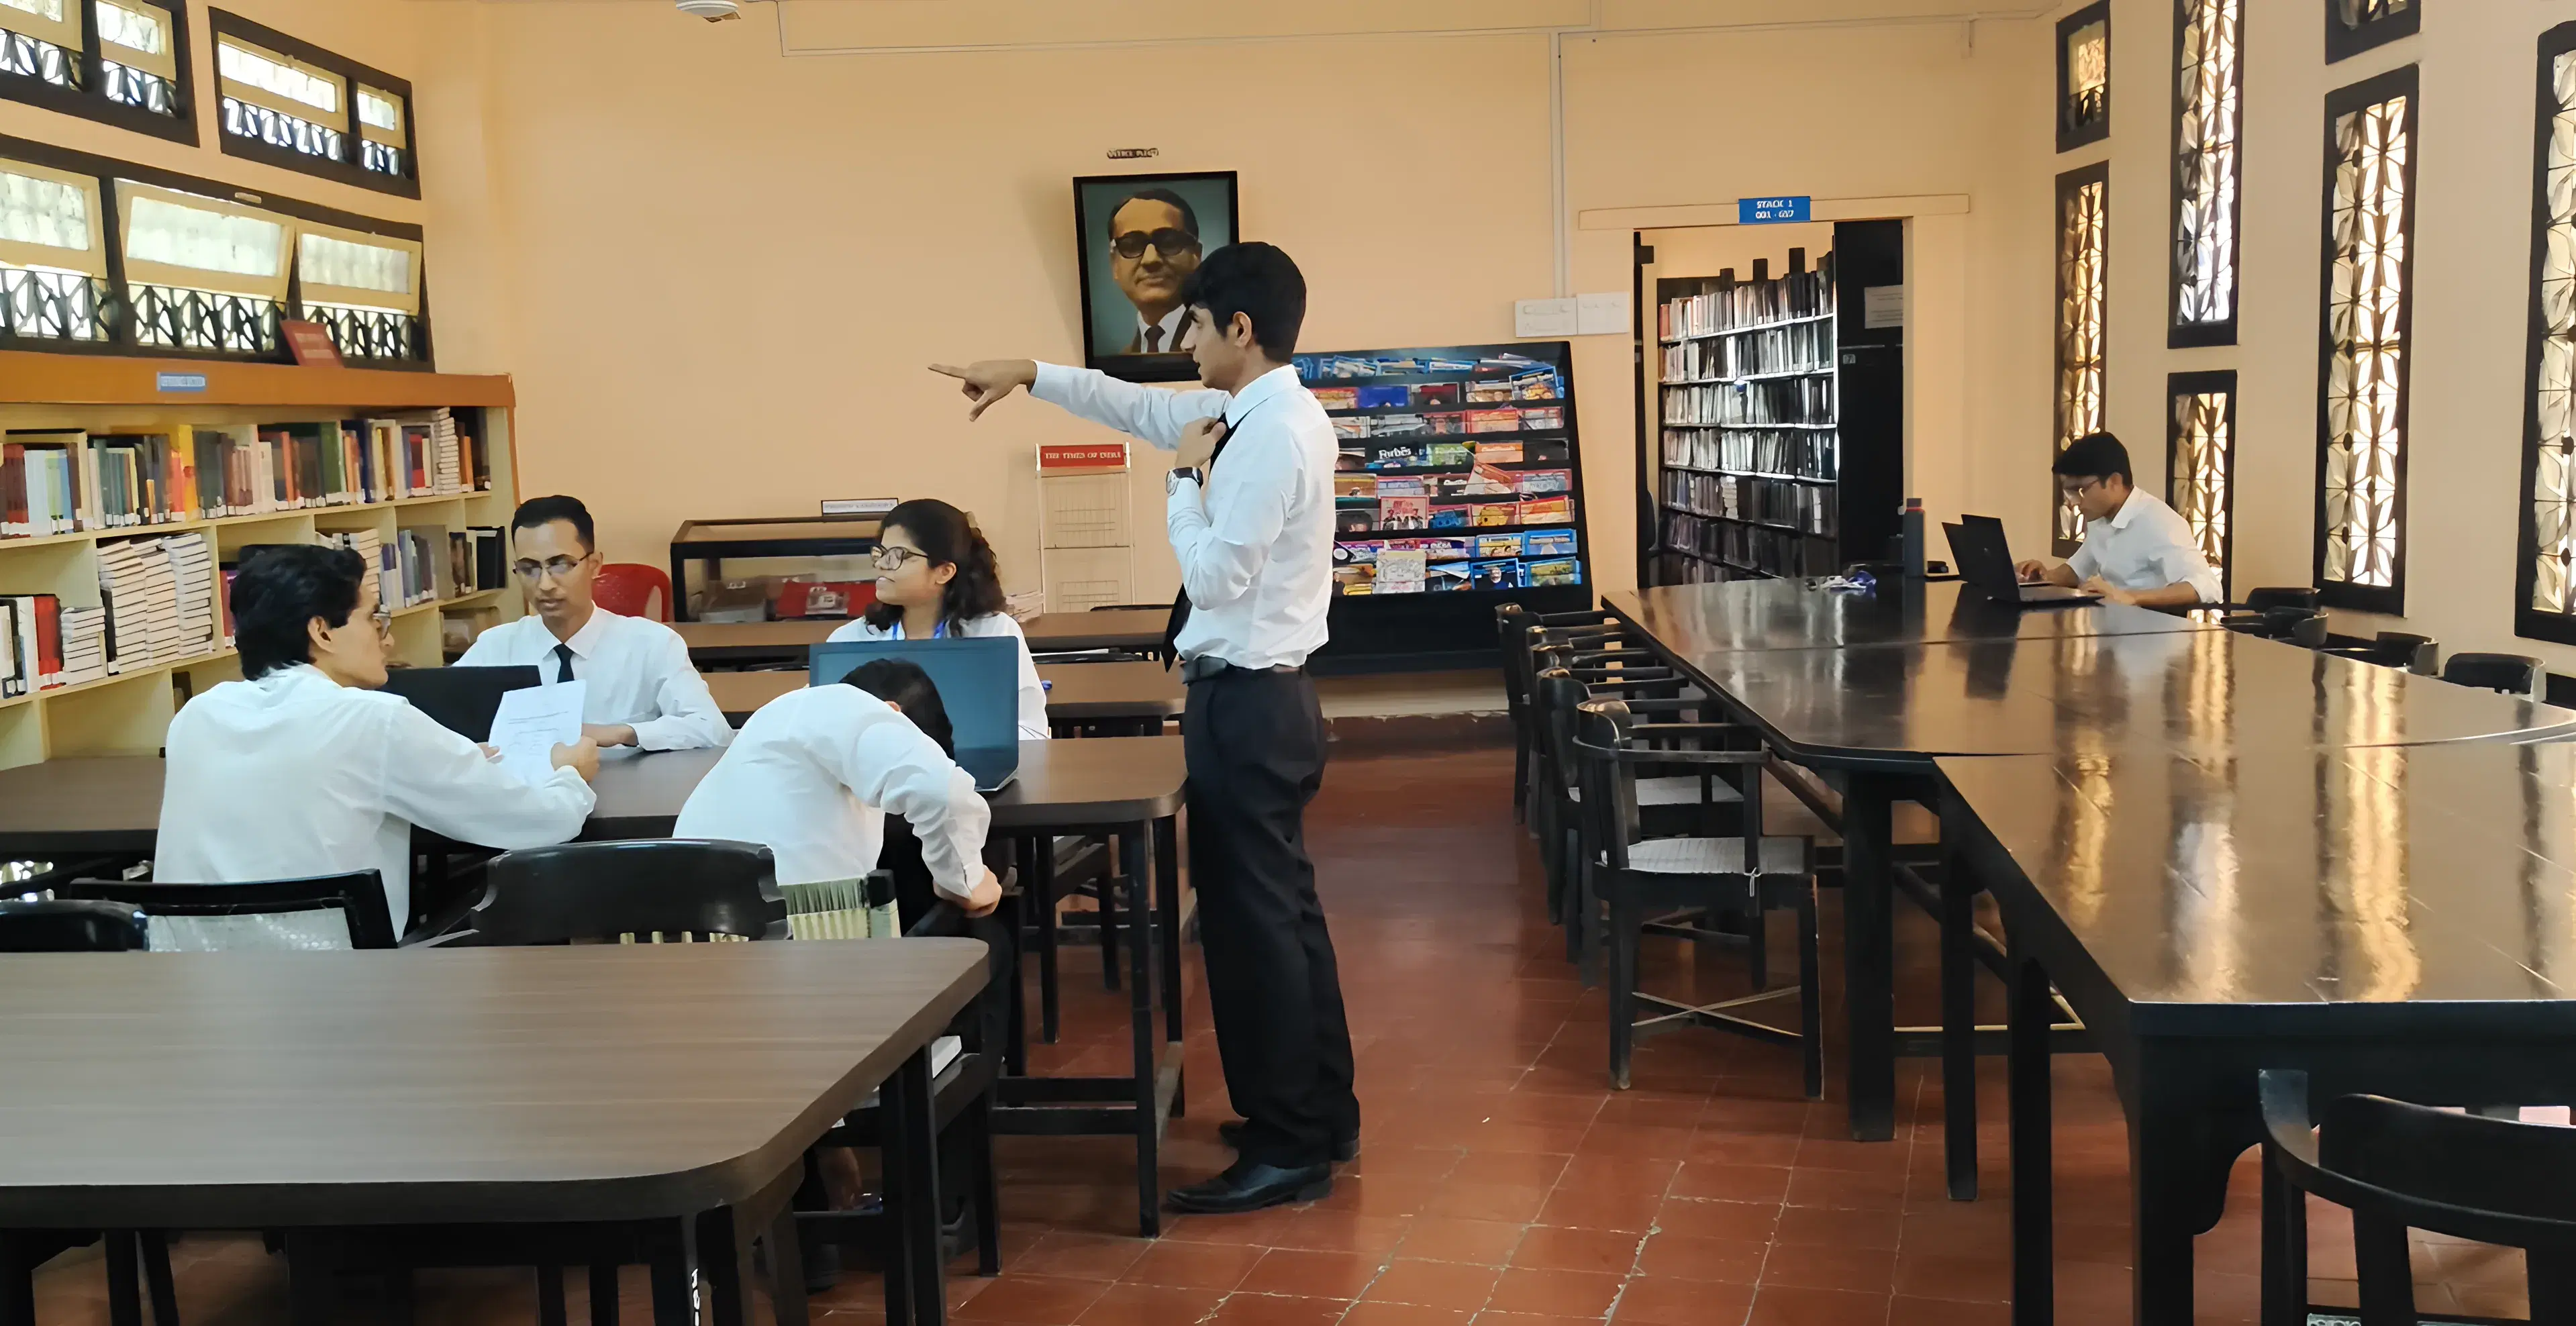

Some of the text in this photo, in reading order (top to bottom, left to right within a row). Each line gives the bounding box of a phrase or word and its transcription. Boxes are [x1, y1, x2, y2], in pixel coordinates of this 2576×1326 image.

[1756, 199, 1793, 209] STACK 1
[1378, 446, 1411, 459] Forbes
